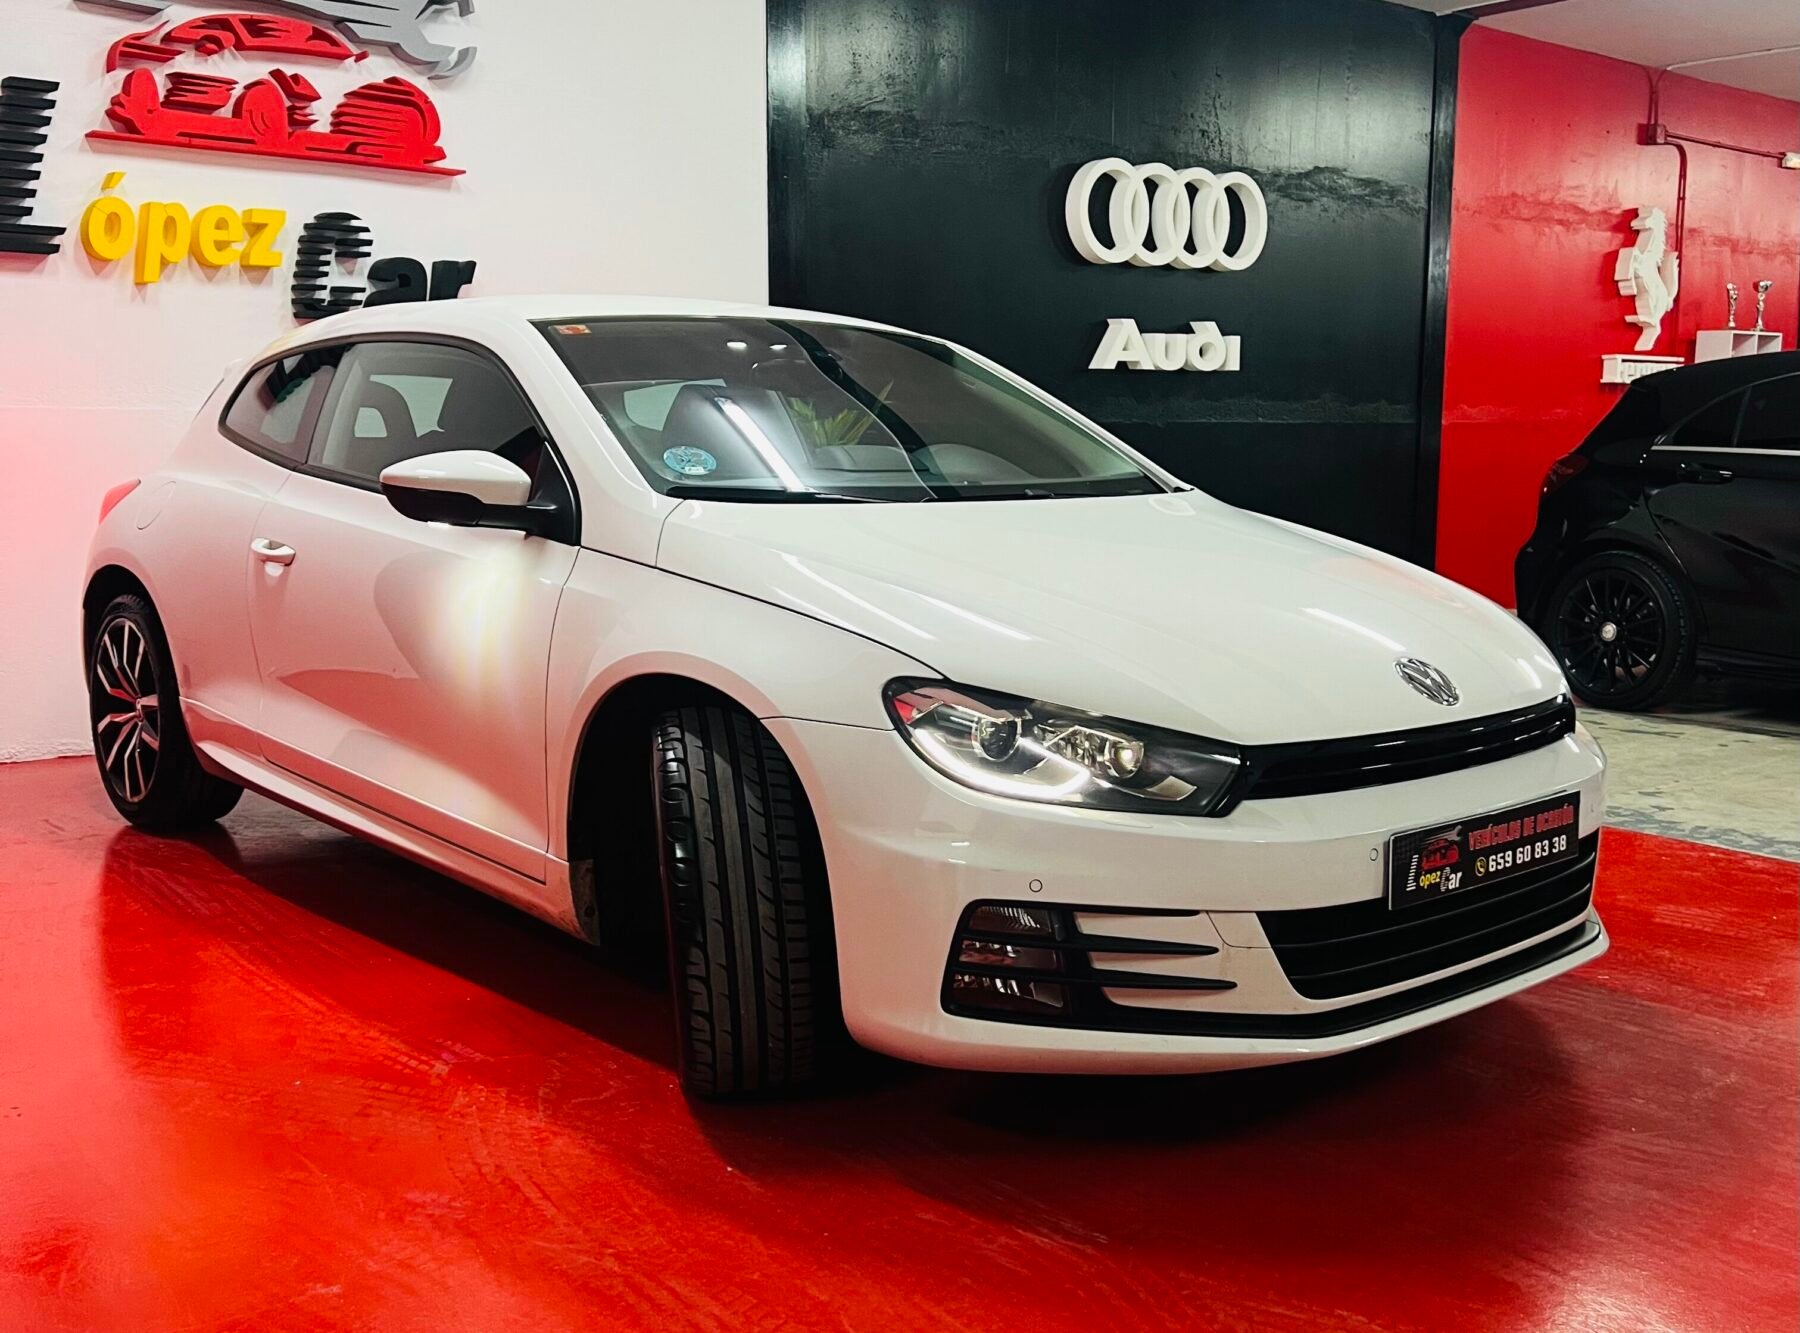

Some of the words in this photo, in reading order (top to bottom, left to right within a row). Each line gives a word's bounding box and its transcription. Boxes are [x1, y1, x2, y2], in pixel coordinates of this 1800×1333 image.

[291, 212, 477, 319] Car
[1088, 318, 1241, 371] Audi
[1488, 850, 1513, 873] 659
[1516, 845, 1531, 864] 60
[1534, 839, 1549, 859] 83
[1552, 834, 1567, 854] 38
